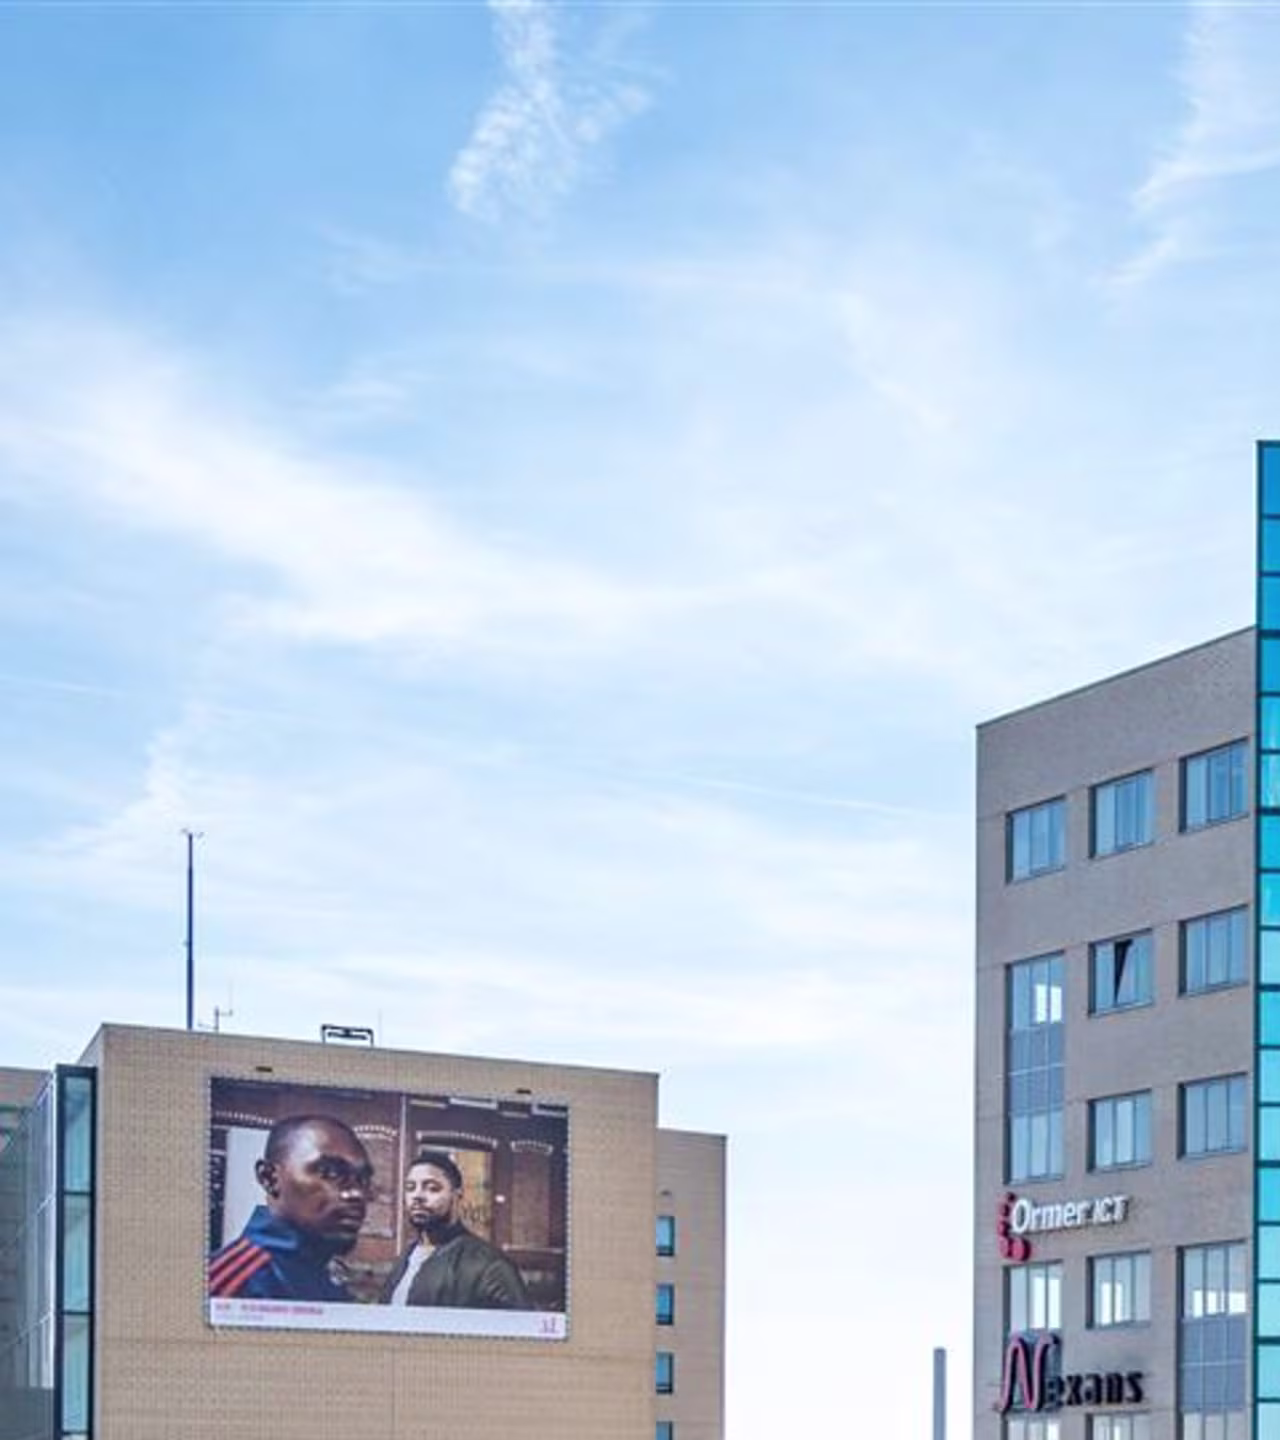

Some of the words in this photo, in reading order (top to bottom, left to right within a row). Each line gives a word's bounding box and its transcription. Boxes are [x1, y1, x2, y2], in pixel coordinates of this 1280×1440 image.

[1010, 1198, 1086, 1234] Ormer
[1092, 1194, 1131, 1224] ICT
[996, 1332, 1144, 1413] Nexans
